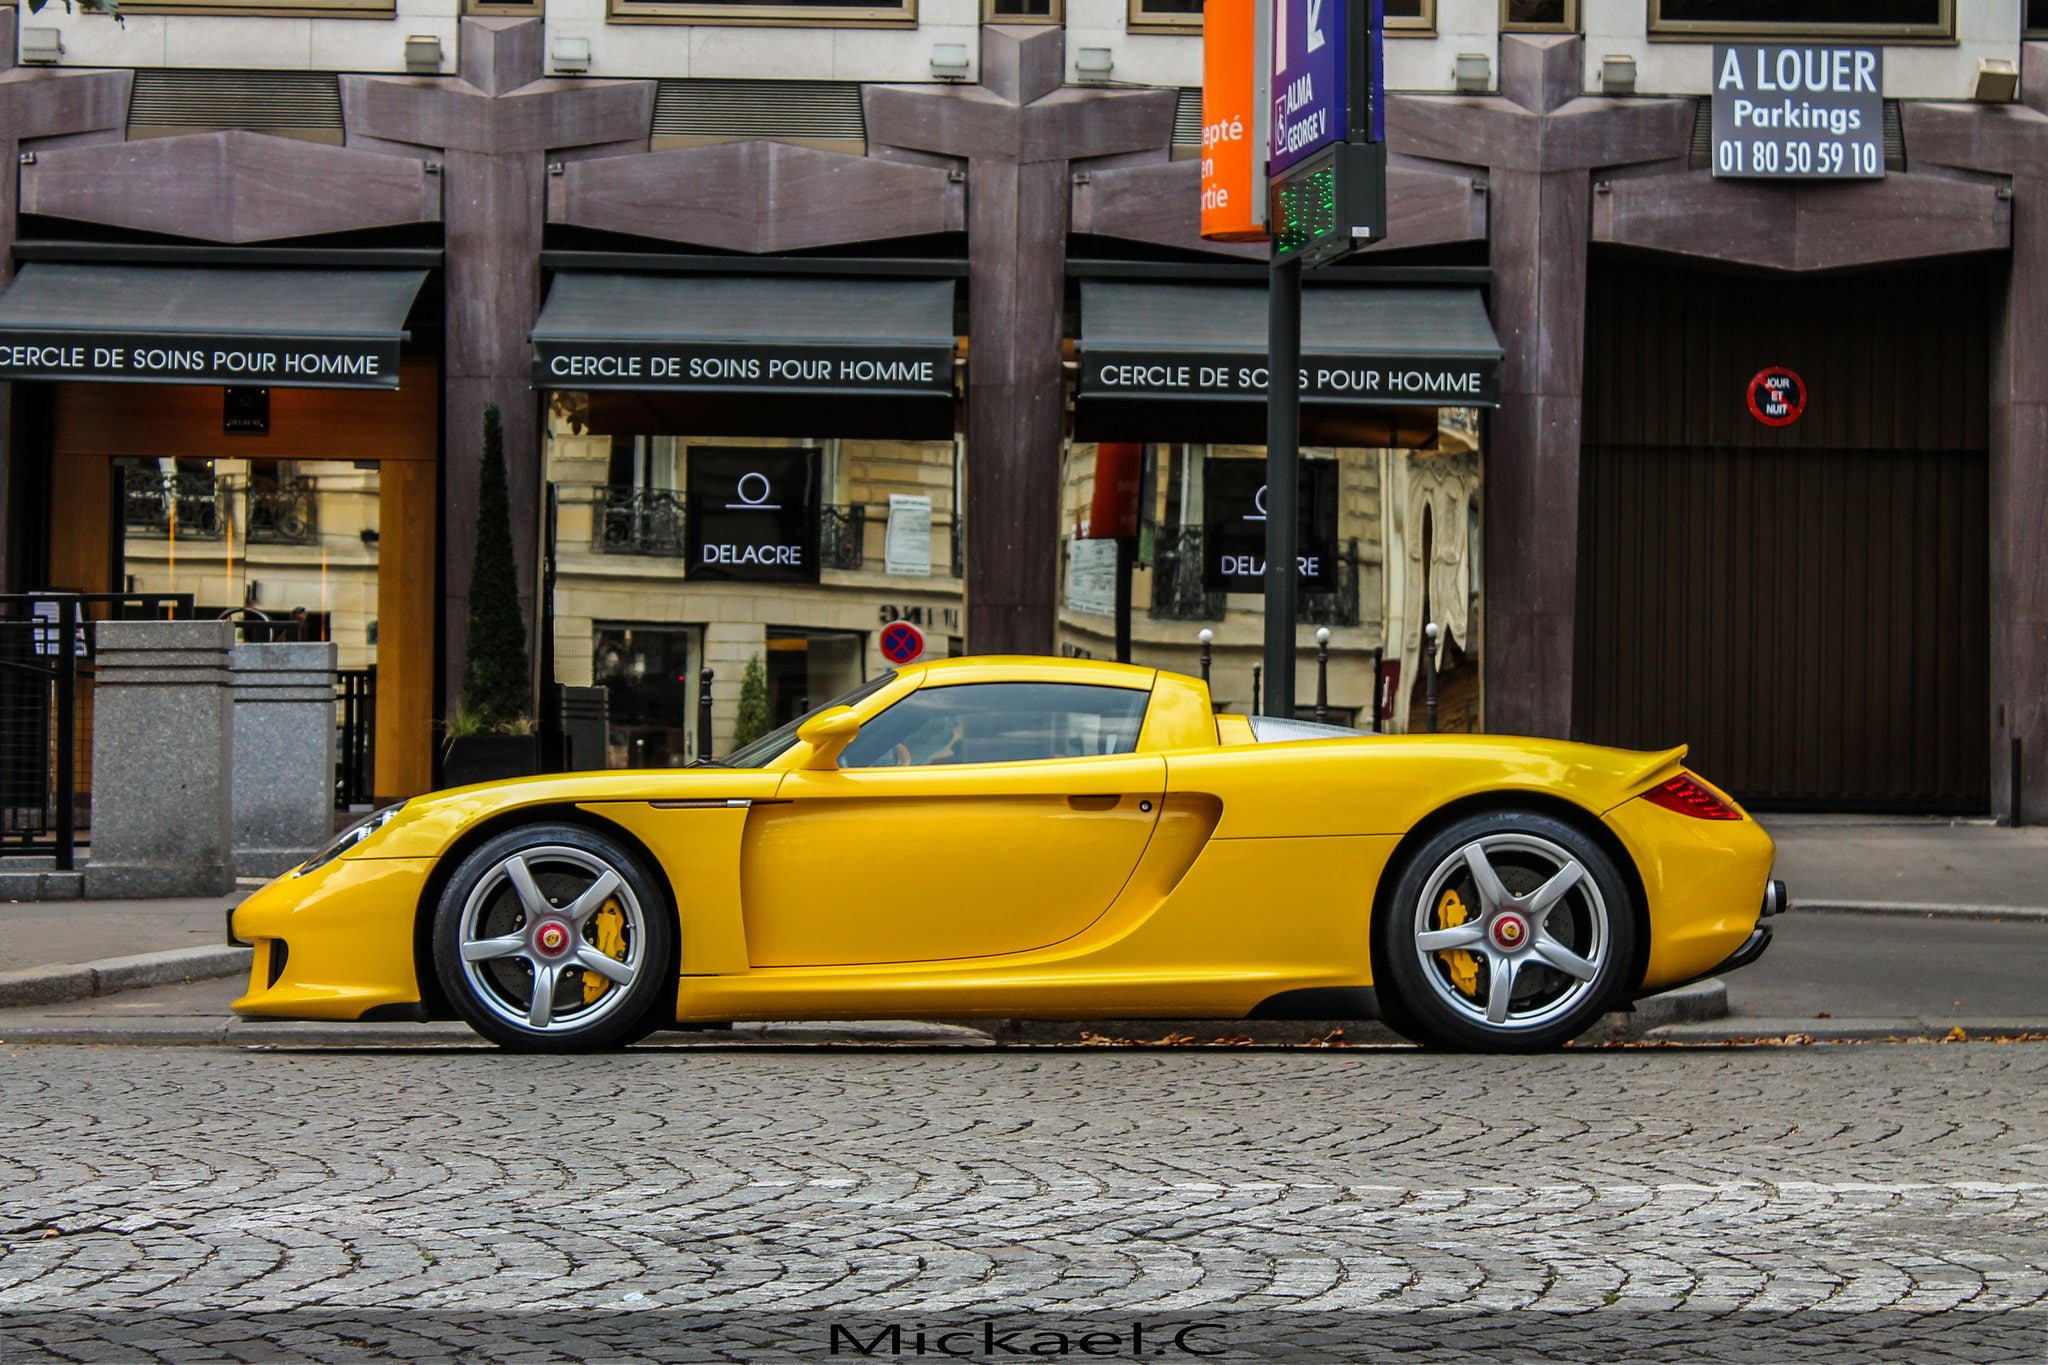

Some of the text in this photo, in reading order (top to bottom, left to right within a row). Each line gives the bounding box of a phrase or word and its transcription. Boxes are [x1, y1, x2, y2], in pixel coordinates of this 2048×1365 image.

[1719, 48, 1877, 92] A LOUER
[1287, 73, 1313, 114] ALMA
[1287, 108, 1325, 152] GEORGE V
[1734, 99, 1861, 135] Parkings
[1719, 140, 1877, 173] 01 80 50 59 10
[1200, 183, 1228, 211] rtie
[0, 346, 378, 375] CERCLE DE SOINS POUR HOMME
[551, 356, 933, 382] CERCLE DE SOINS POUR HOMME
[1100, 366, 1481, 393] CERCLE DE SOS POUR HOMME
[1765, 377, 1790, 389] JOUR
[1766, 404, 1788, 415] NUIT
[1771, 391, 1783, 402] ET
[703, 544, 801, 565] DELACRE
[1221, 555, 1319, 576] DELRE
